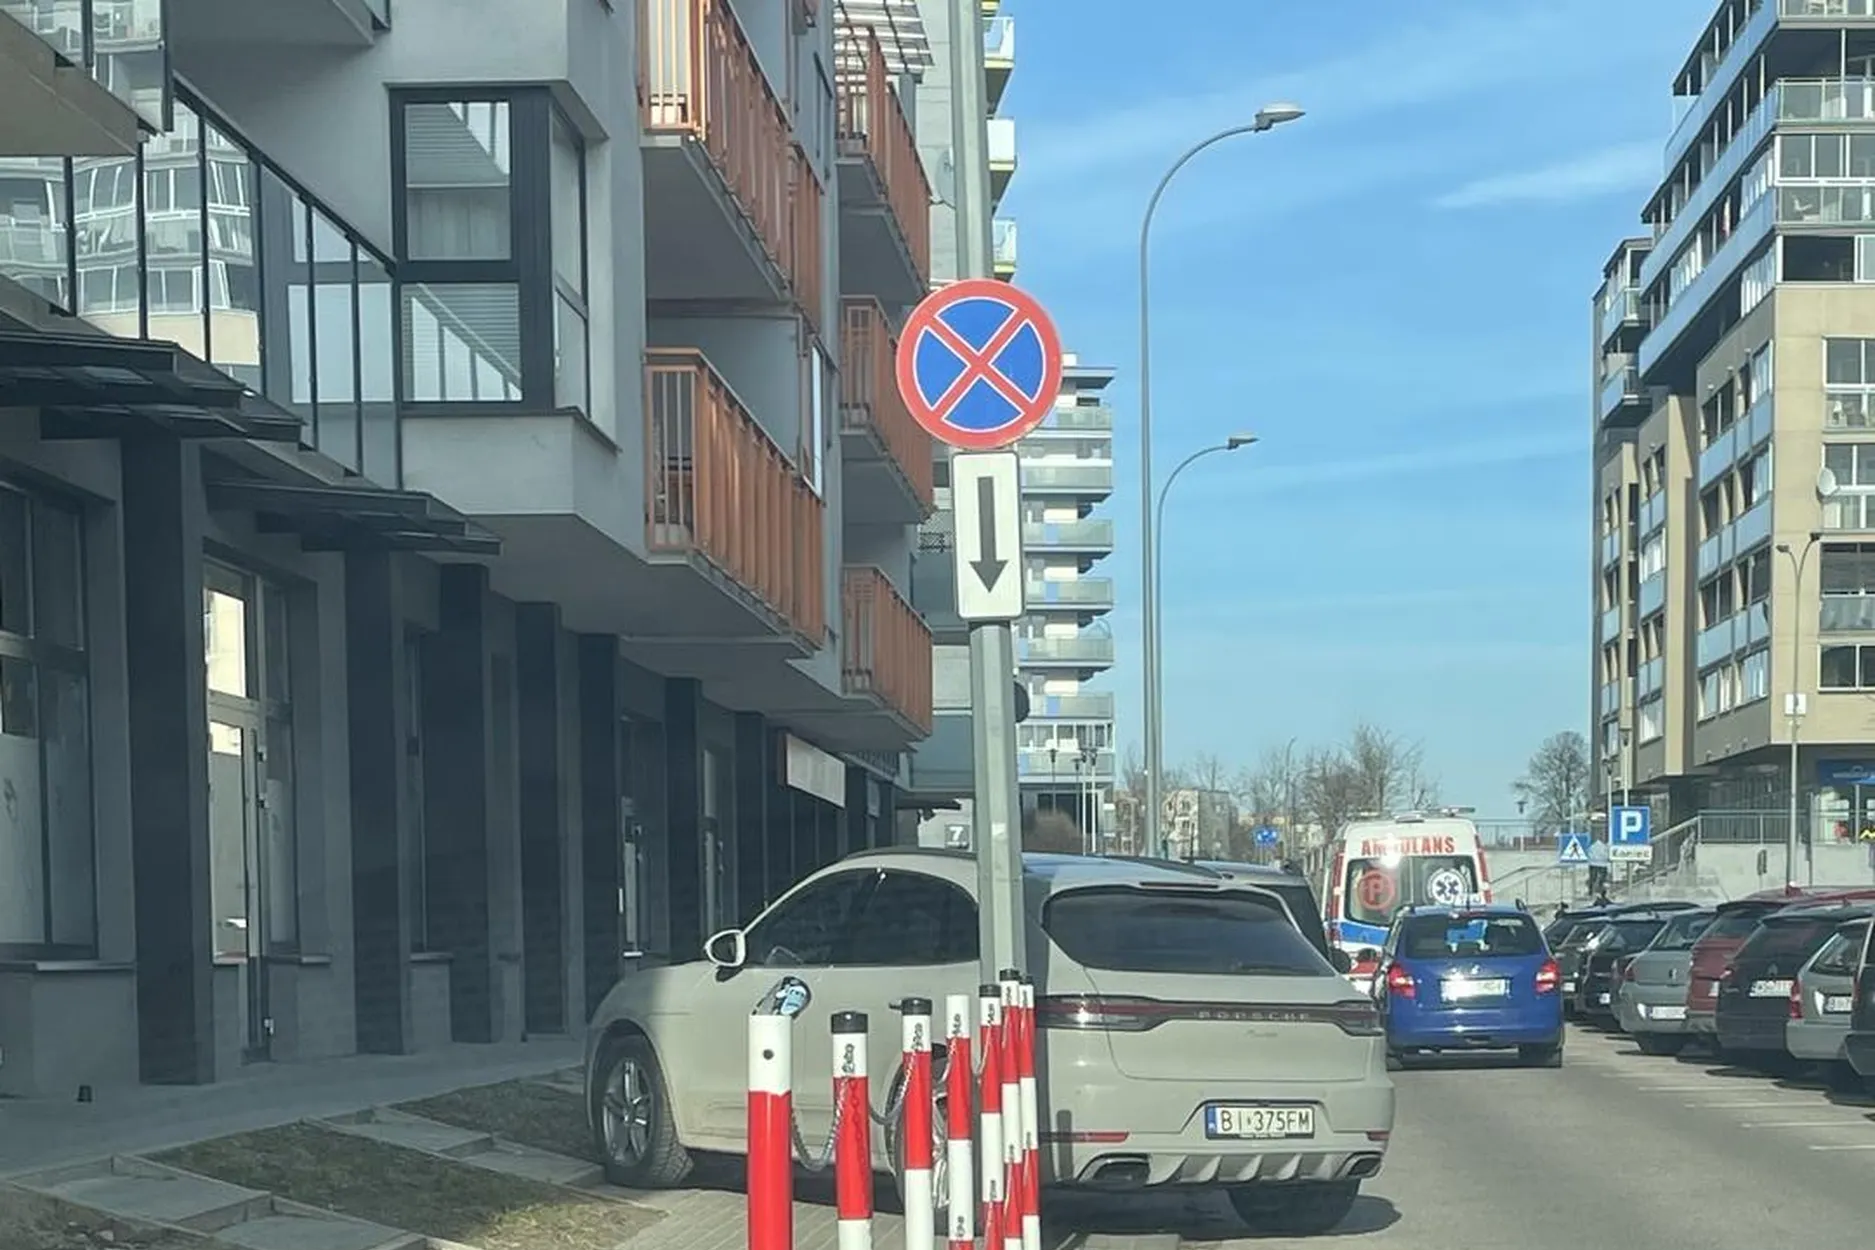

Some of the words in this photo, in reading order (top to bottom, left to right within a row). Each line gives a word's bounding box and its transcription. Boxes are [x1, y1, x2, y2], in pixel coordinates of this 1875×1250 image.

[950, 826, 963, 841] 7
[1621, 811, 1642, 841] P
[1361, 836, 1456, 856] AMULANS
[1253, 1110, 1310, 1132] 375FM
